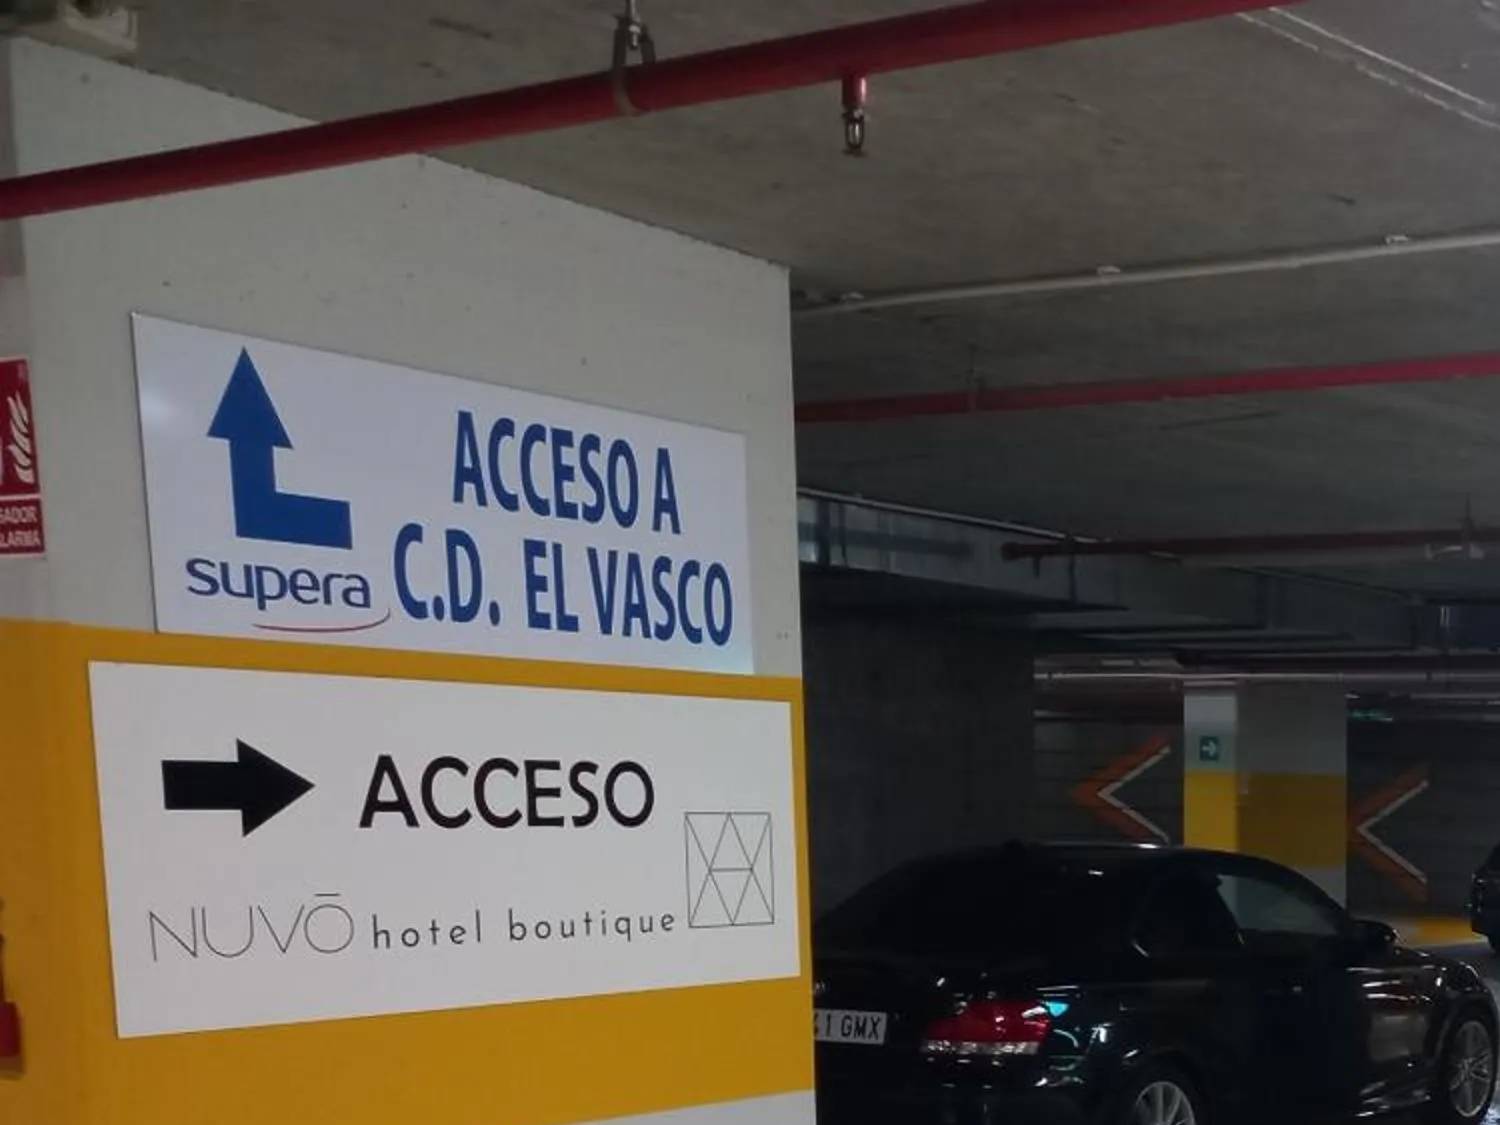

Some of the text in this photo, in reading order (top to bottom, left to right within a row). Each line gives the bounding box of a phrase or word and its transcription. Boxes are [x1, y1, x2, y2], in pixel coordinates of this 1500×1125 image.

[453, 410, 681, 535] ACCESO A
[185, 557, 371, 611] supera
[394, 523, 733, 646] C.D. EL VASCO
[359, 753, 655, 830] ACCESO
[371, 908, 482, 950] hotel
[508, 908, 675, 944] boutique
[841, 1014, 881, 1040] GMX
